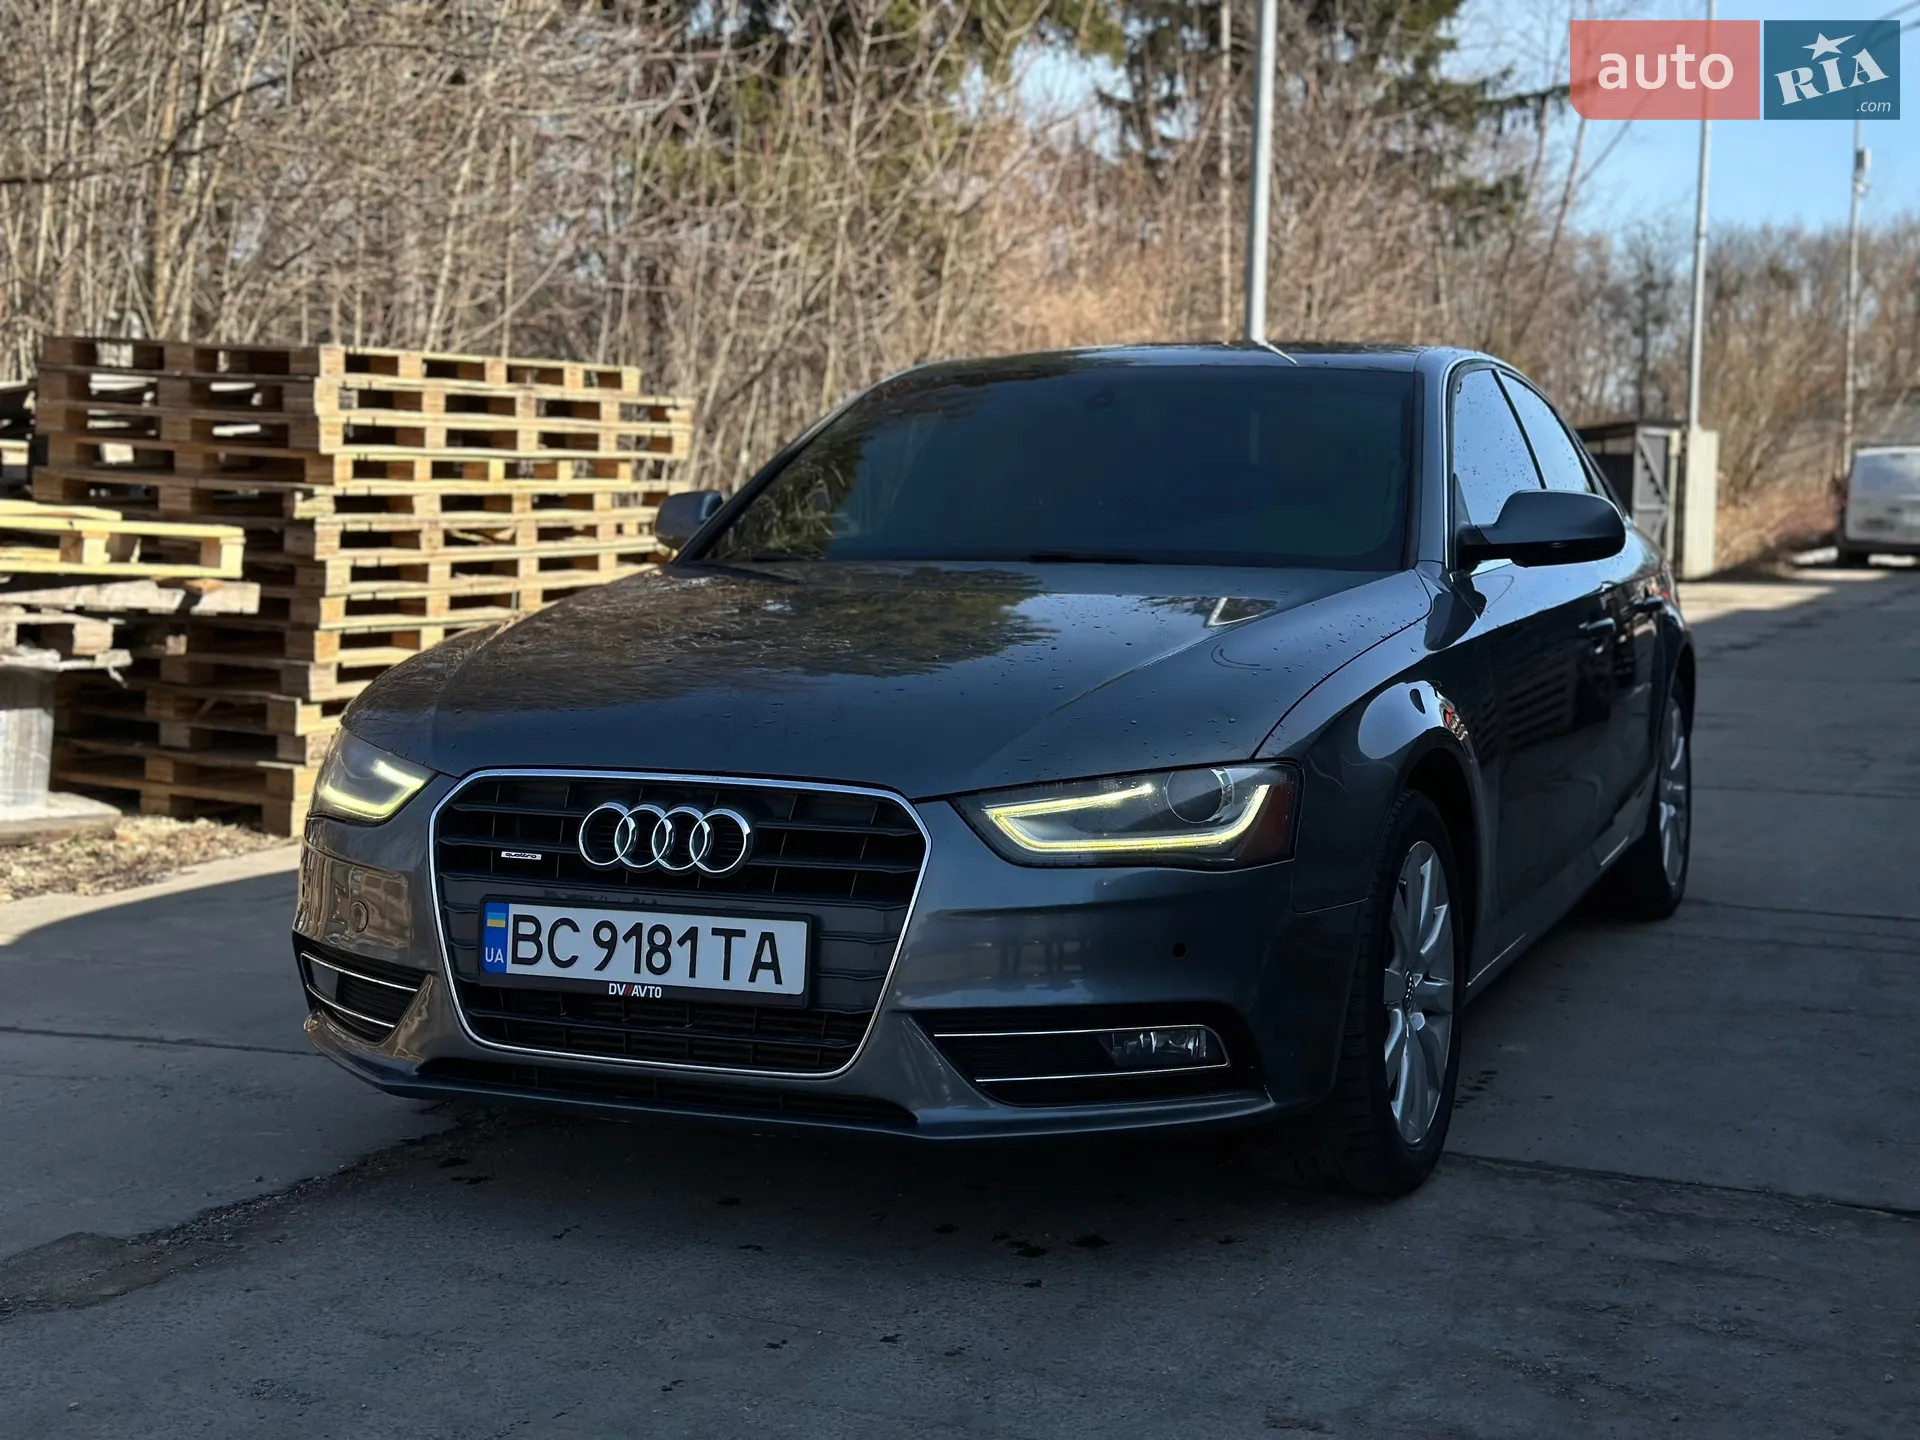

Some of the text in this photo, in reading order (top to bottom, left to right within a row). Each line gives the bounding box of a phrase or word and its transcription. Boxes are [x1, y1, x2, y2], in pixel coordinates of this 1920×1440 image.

[485, 947, 504, 964] UA
[511, 914, 783, 985] BC 9181 TA
